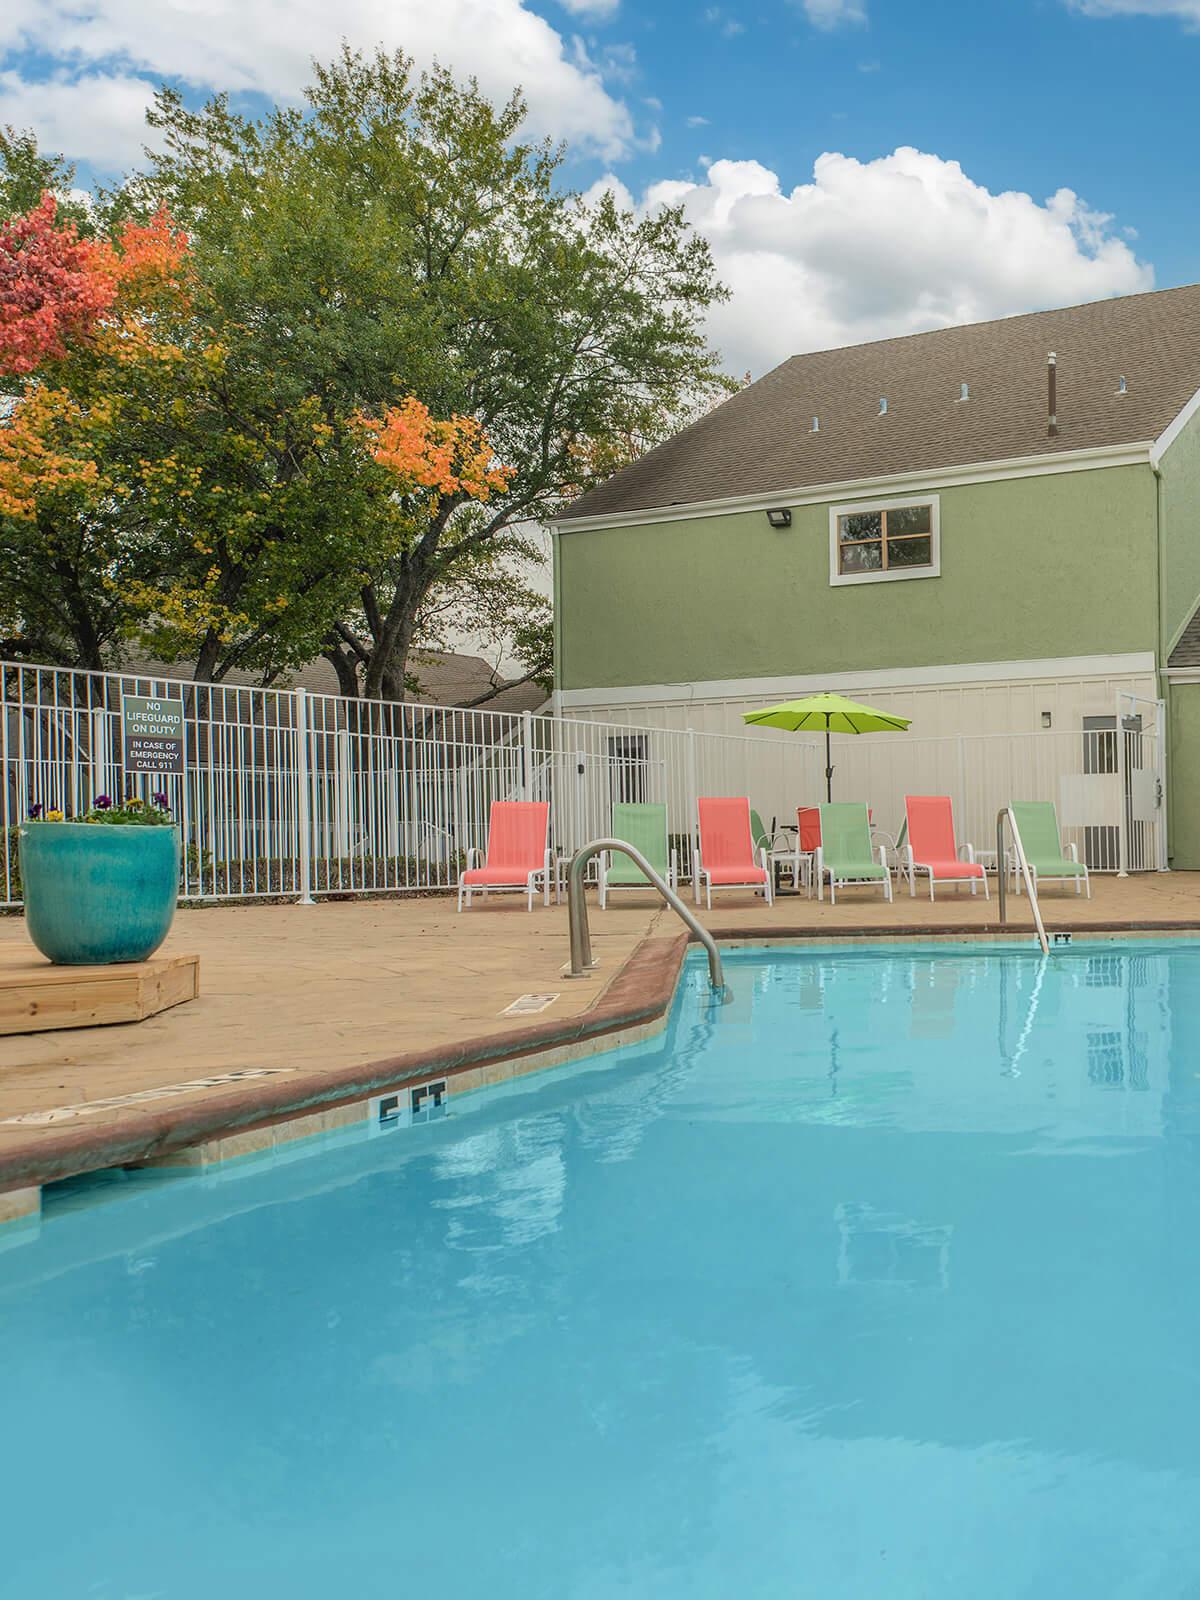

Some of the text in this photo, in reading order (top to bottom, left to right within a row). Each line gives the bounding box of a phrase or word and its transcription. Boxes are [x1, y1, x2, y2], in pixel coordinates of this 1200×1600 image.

[146, 702, 160, 711] NO
[127, 712, 180, 724] LIFEGUARD
[132, 724, 176, 735] ON DUTY
[143, 741, 164, 749] CASE
[130, 751, 179, 760] EMERGENCY
[136, 761, 157, 769] CALL
